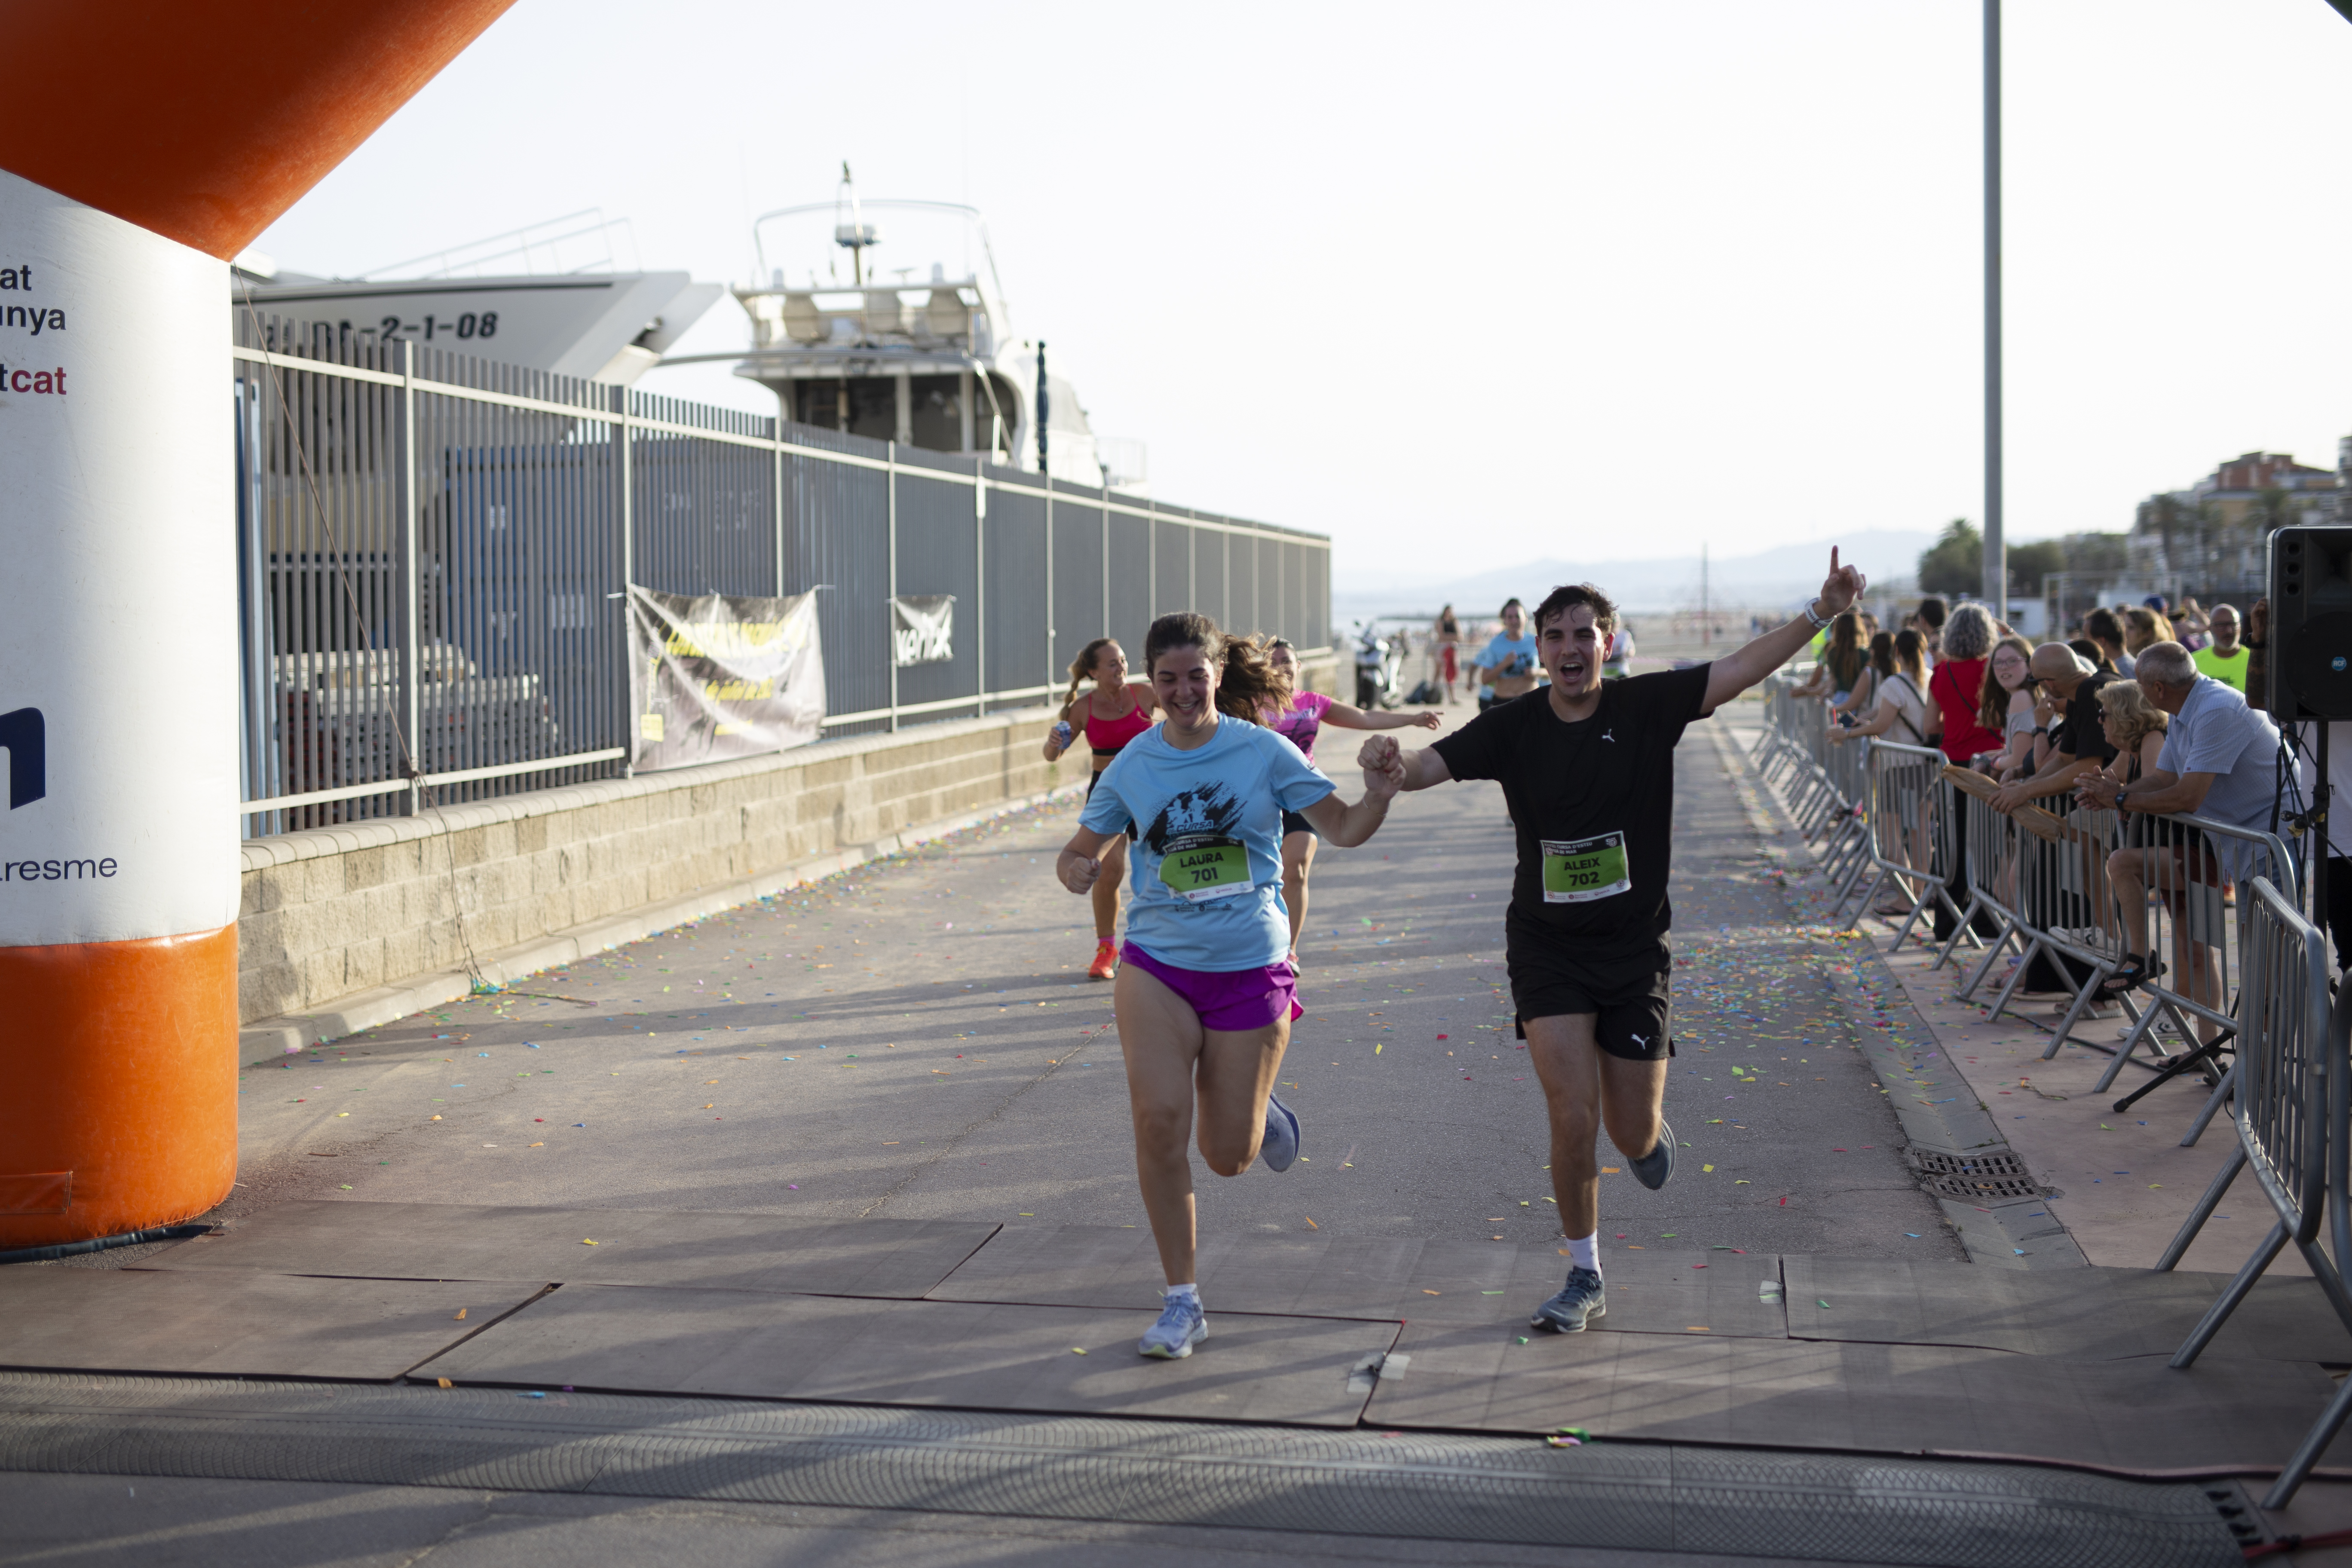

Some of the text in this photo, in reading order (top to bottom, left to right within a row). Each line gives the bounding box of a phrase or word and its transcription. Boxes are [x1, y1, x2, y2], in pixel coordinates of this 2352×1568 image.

[0, 265, 32, 291] at
[0, 305, 67, 336] nya
[1176, 821, 1212, 832] CURSA
[1180, 852, 1224, 868] LAURA
[1564, 857, 1602, 871] ALEIX
[0, 857, 118, 882] resme
[1191, 867, 1219, 884] 701
[1569, 871, 1600, 886] 702
